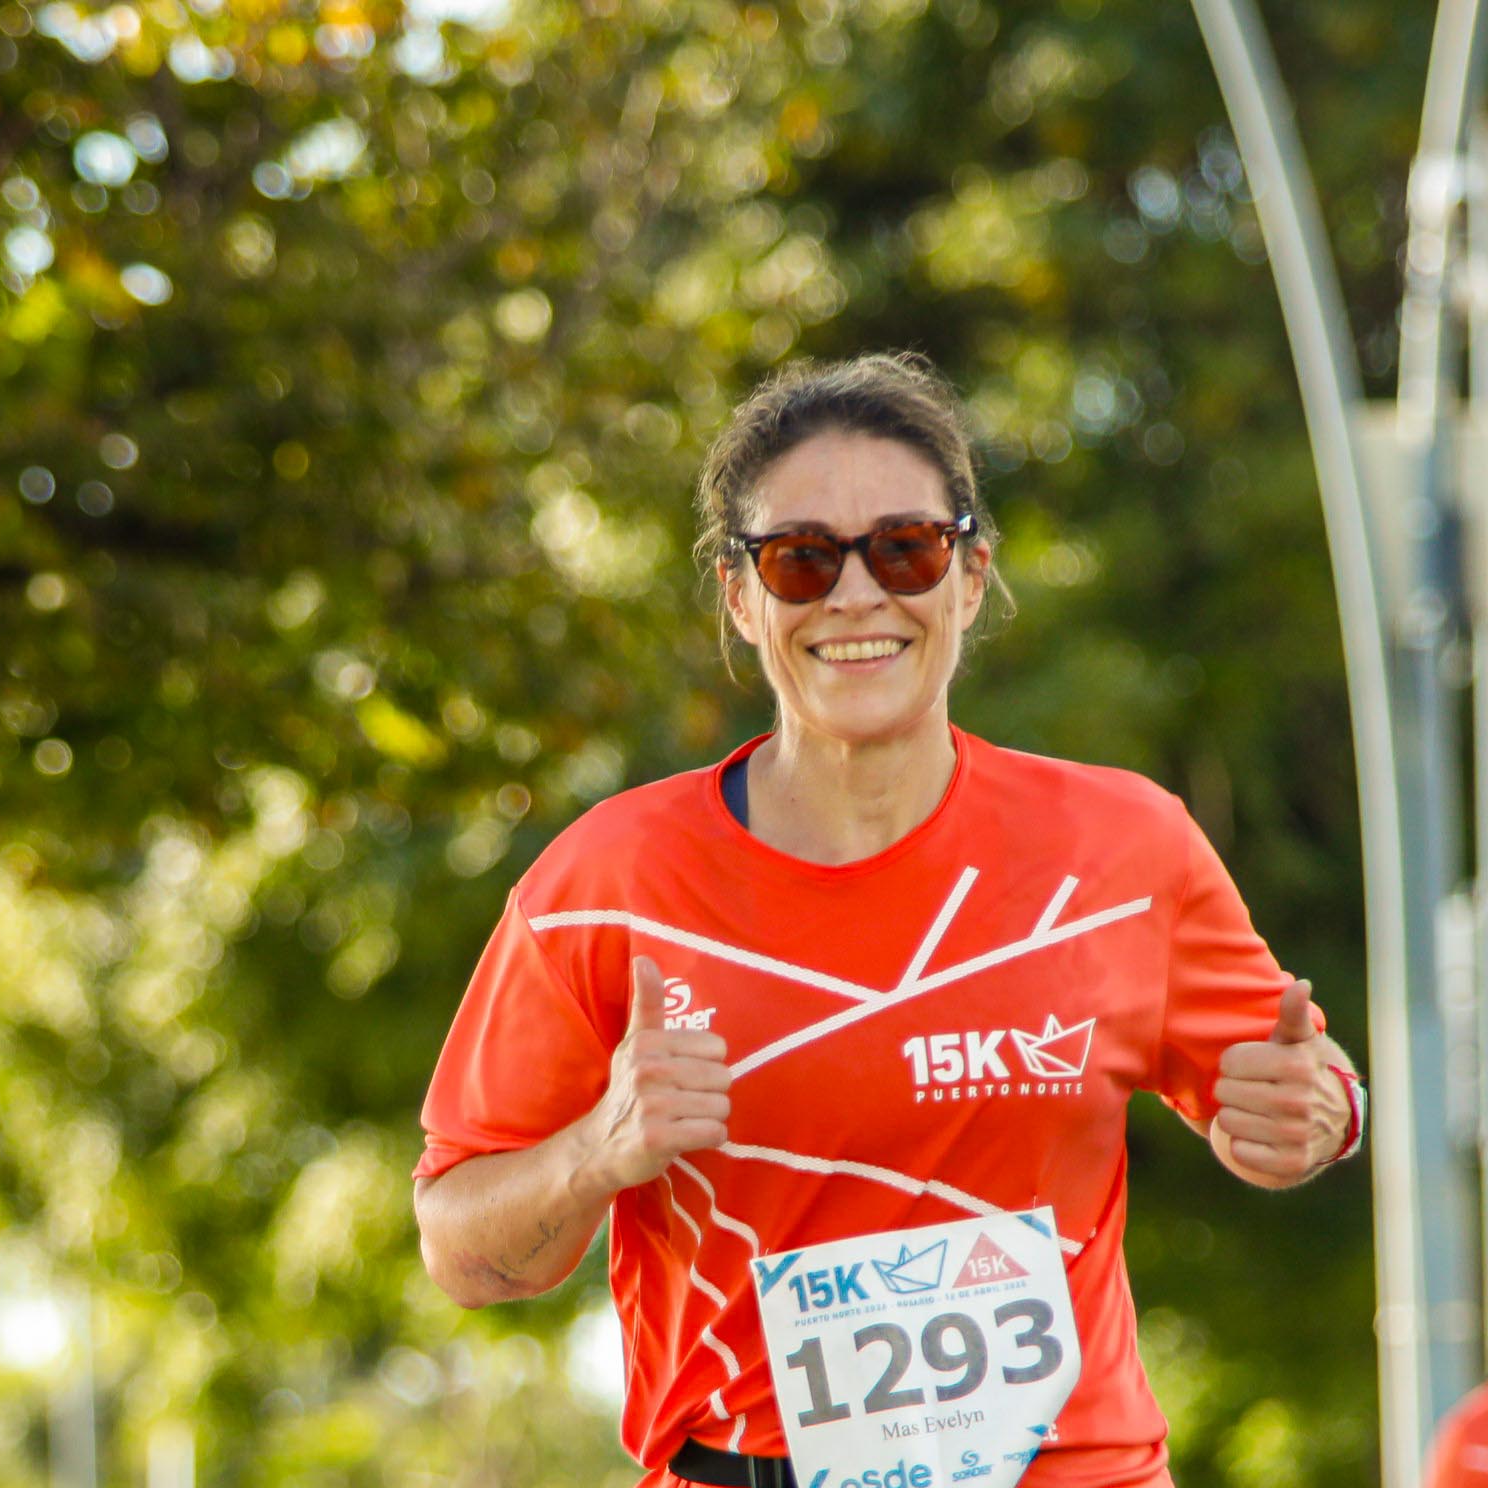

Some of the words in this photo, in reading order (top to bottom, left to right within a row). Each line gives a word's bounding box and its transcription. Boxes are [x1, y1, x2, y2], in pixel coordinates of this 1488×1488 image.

[903, 1030, 1011, 1086] 15K
[916, 1083, 1010, 1104] PUERTO
[1020, 1082, 1083, 1096] NORTE
[967, 1253, 1010, 1279] 15K
[788, 1262, 871, 1313] 15K
[794, 1315, 830, 1327] PUERTO
[832, 1309, 861, 1320] NORTE
[785, 1298, 1064, 1428] 1293
[881, 1421, 920, 1442] Mas
[924, 1408, 985, 1434] Evelyn
